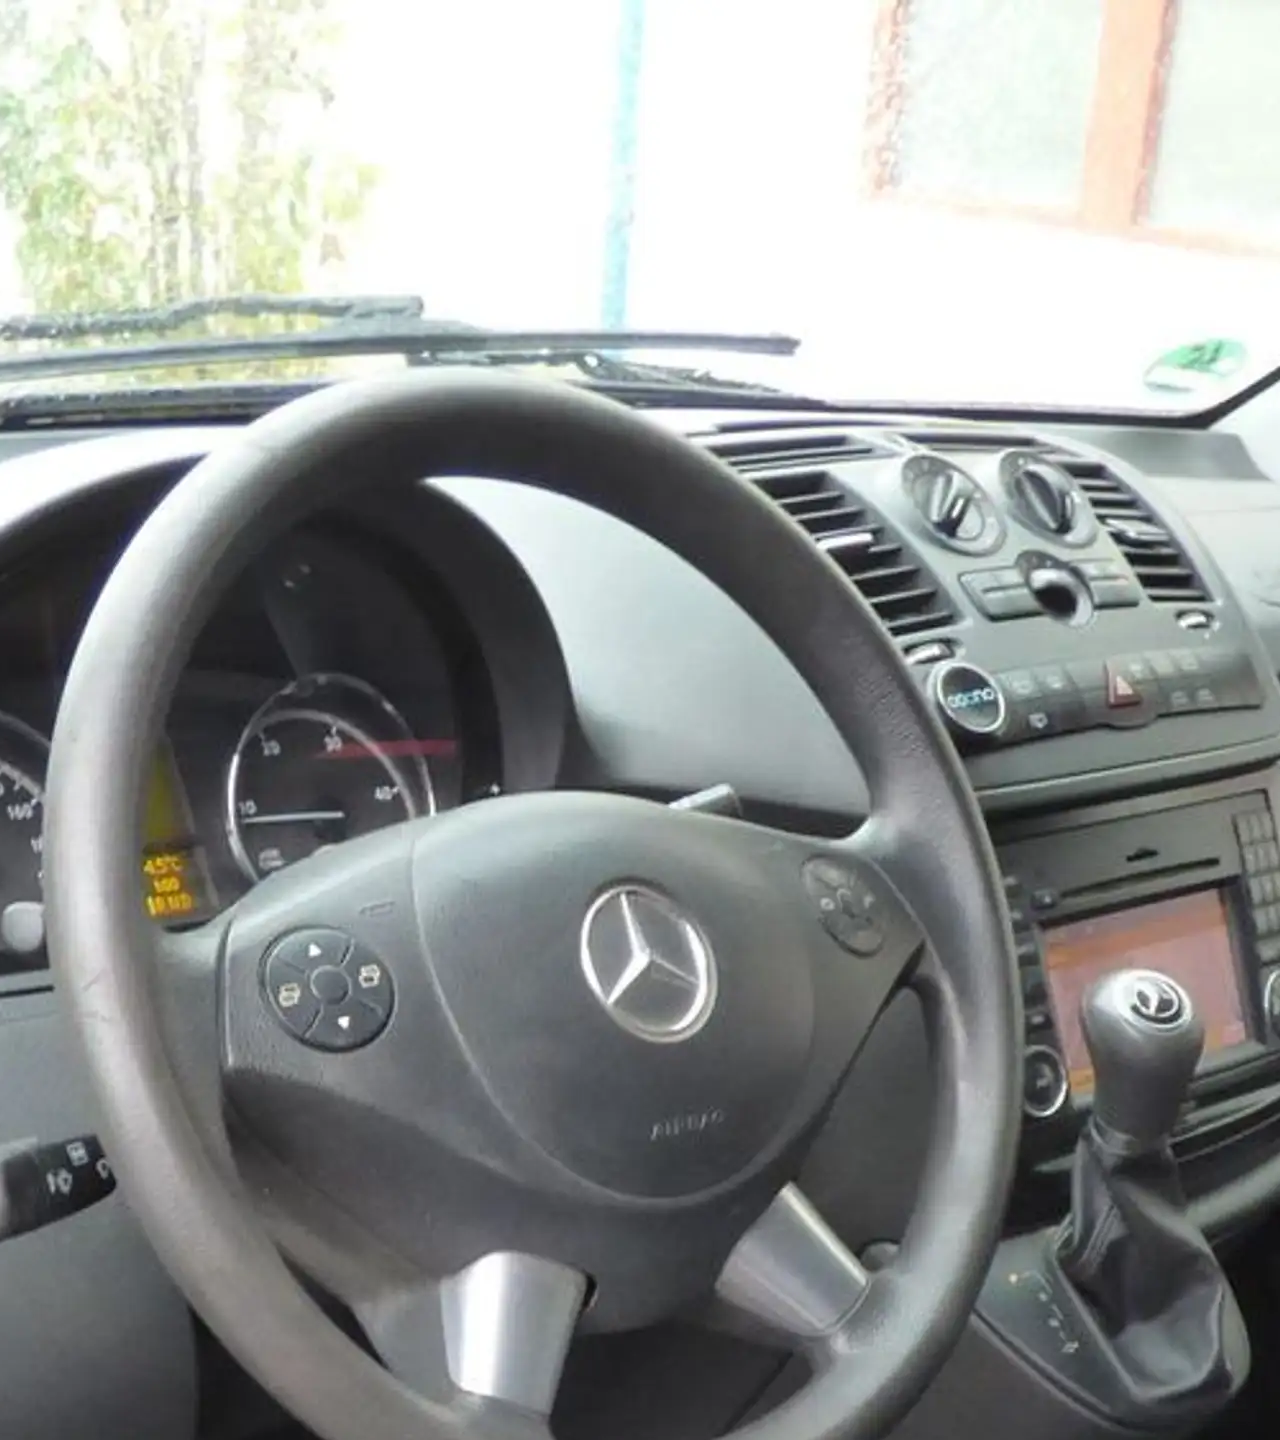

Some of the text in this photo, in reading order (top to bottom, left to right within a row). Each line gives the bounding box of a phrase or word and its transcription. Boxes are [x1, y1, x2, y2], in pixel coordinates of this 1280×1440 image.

[324, 735, 342, 752] 30
[375, 786, 392, 800] 40
[7, 803, 33, 820] 160
[239, 800, 257, 815] 10
